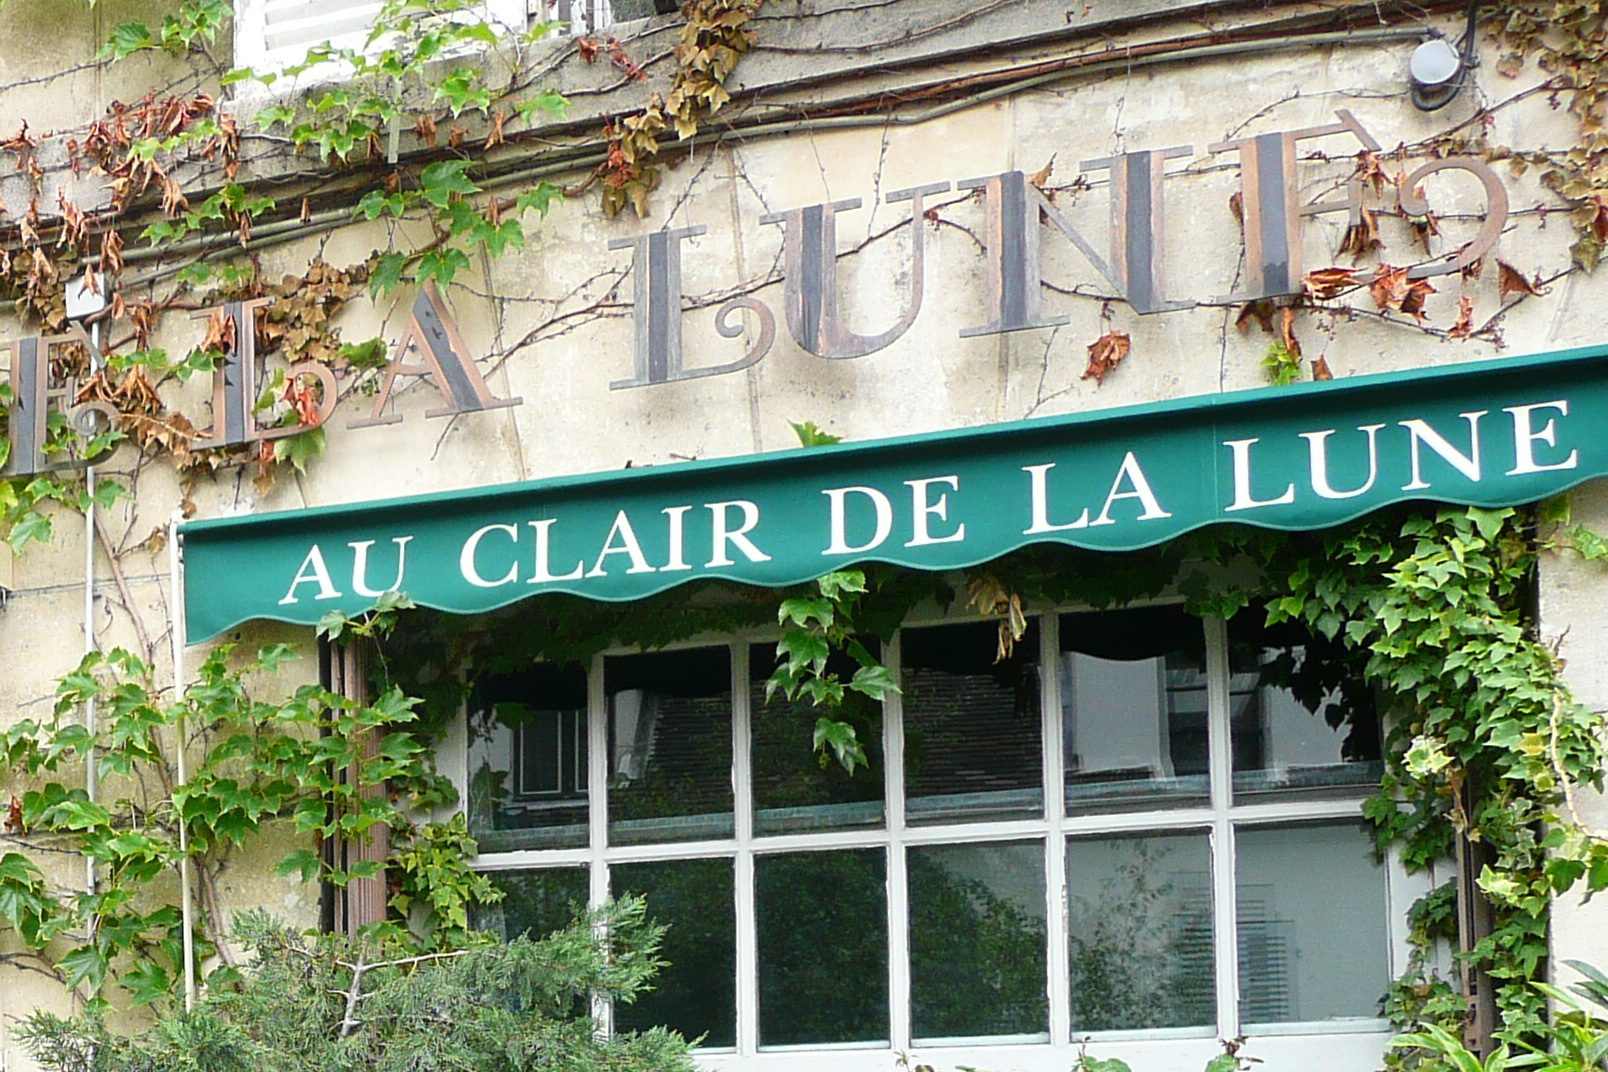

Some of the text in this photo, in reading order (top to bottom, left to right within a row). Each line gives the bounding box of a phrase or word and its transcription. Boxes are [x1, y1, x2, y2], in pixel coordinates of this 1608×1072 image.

[189, 279, 524, 450] LA
[608, 108, 1511, 391] LUNE
[278, 400, 1578, 606] AU CLAIR DE LA LUNE
